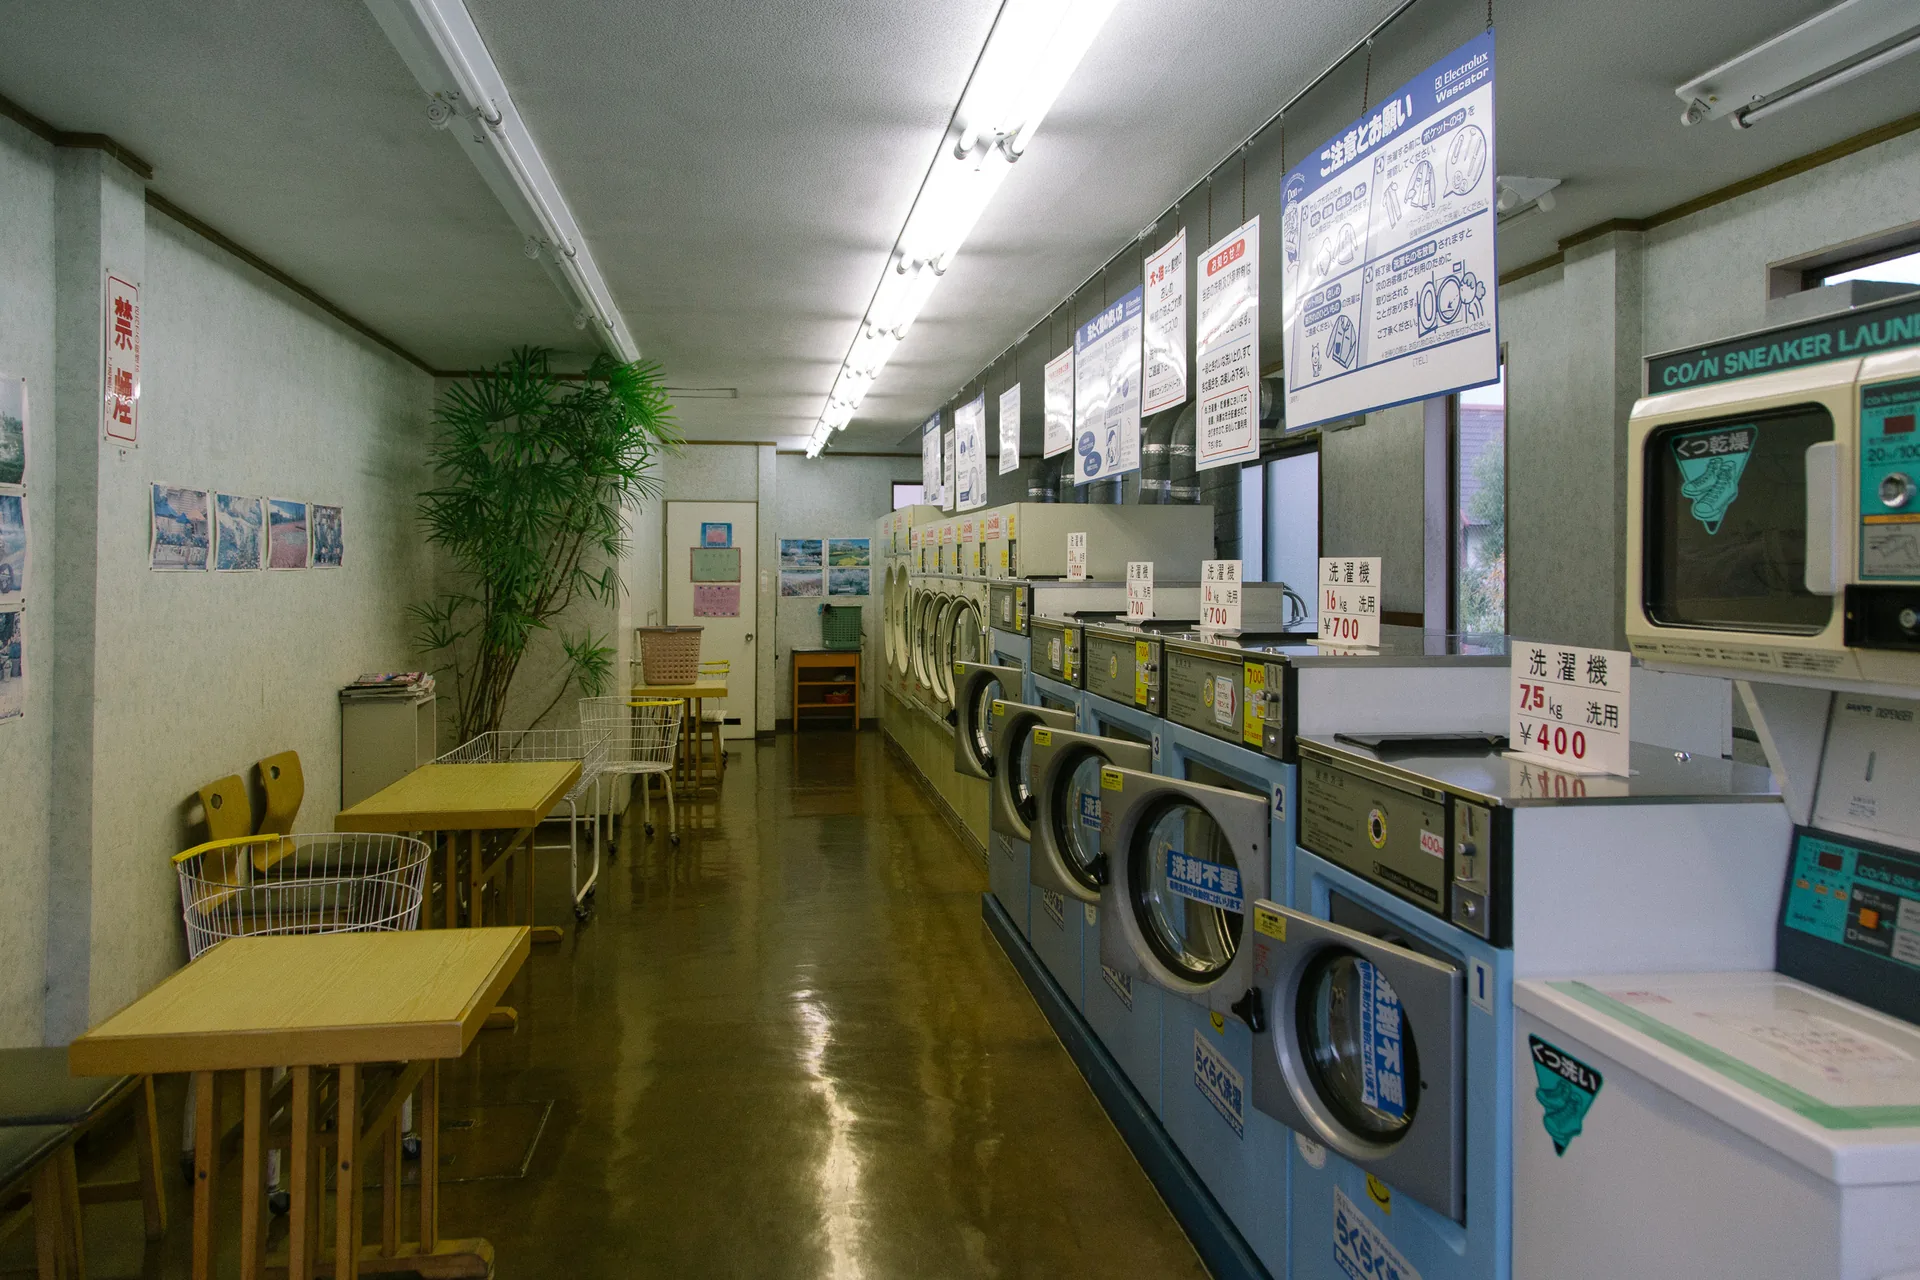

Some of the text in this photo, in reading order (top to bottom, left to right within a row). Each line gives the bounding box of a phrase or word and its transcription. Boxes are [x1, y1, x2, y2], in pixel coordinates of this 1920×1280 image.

[1444, 52, 1488, 84] Electrolux
[1436, 68, 1489, 103] Wascator
[1320, 94, 1412, 177] ご注意とお願い
[1376, 286, 1408, 306] 取り出される
[1376, 298, 1418, 320] ことがあります。
[1724, 334, 1832, 374] SNEAKER
[1677, 432, 1750, 457] くつ乾燥
[1207, 563, 1235, 581] 洗濯機
[1328, 561, 1370, 583] 洗濯機
[1205, 585, 1212, 602] 16
[1326, 589, 1375, 613] 16 kg 洗用
[1323, 617, 1359, 640] ¥700
[1529, 649, 1608, 686] 洗濯機
[1519, 684, 1619, 729] 7.5 kg 洗用
[1154, 736, 1160, 755] 3
[1519, 722, 1586, 760] ¥400
[1275, 787, 1284, 813] 2
[1172, 854, 1238, 895] 洗剤不要
[1476, 964, 1485, 1001] 1
[1376, 970, 1403, 1107] 洗剤不要
[1196, 1046, 1243, 1118] らくらく洗濯
[1532, 1044, 1597, 1091] くつ洗い
